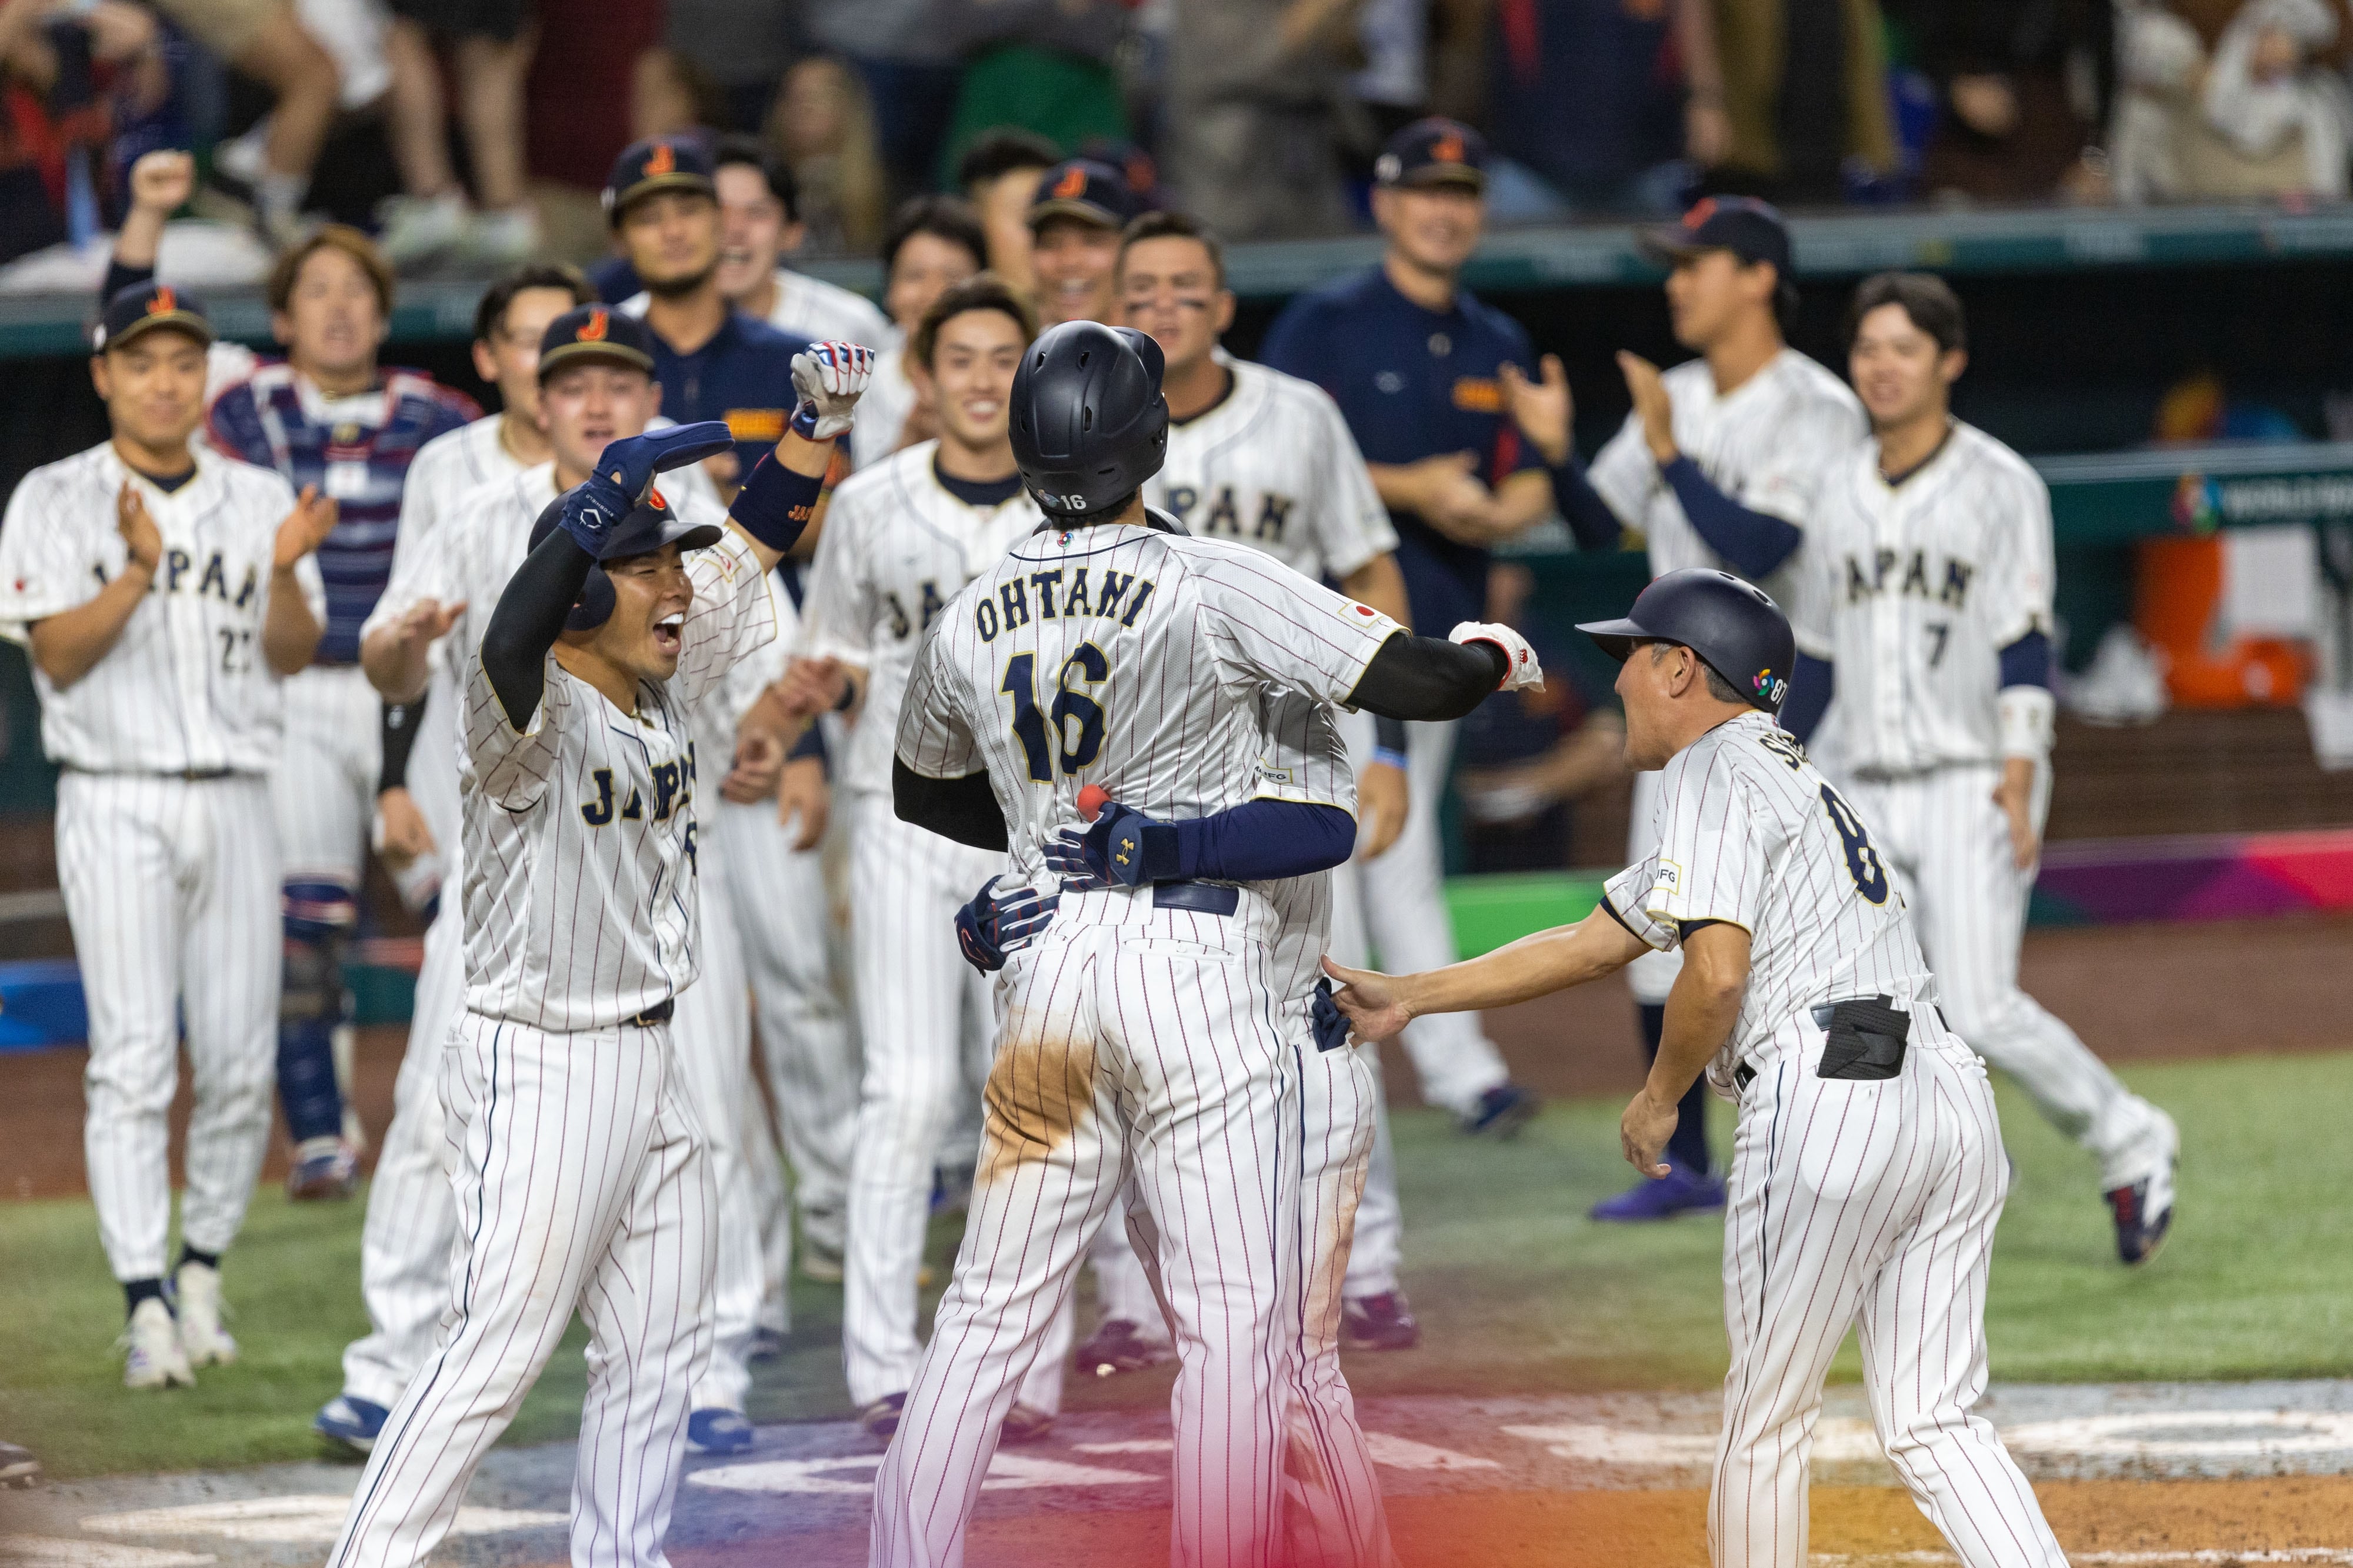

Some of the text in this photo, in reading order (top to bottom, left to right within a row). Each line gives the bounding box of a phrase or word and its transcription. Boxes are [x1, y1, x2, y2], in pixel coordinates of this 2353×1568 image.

[641, 145, 676, 176] J
[1052, 166, 1088, 199] J
[575, 308, 609, 342] J
[1060, 494, 1087, 511] 16
[976, 566, 1156, 643] OHTANI
[1924, 622, 1949, 670] 7
[1770, 678, 1788, 705] 87
[999, 639, 1111, 785] 16
